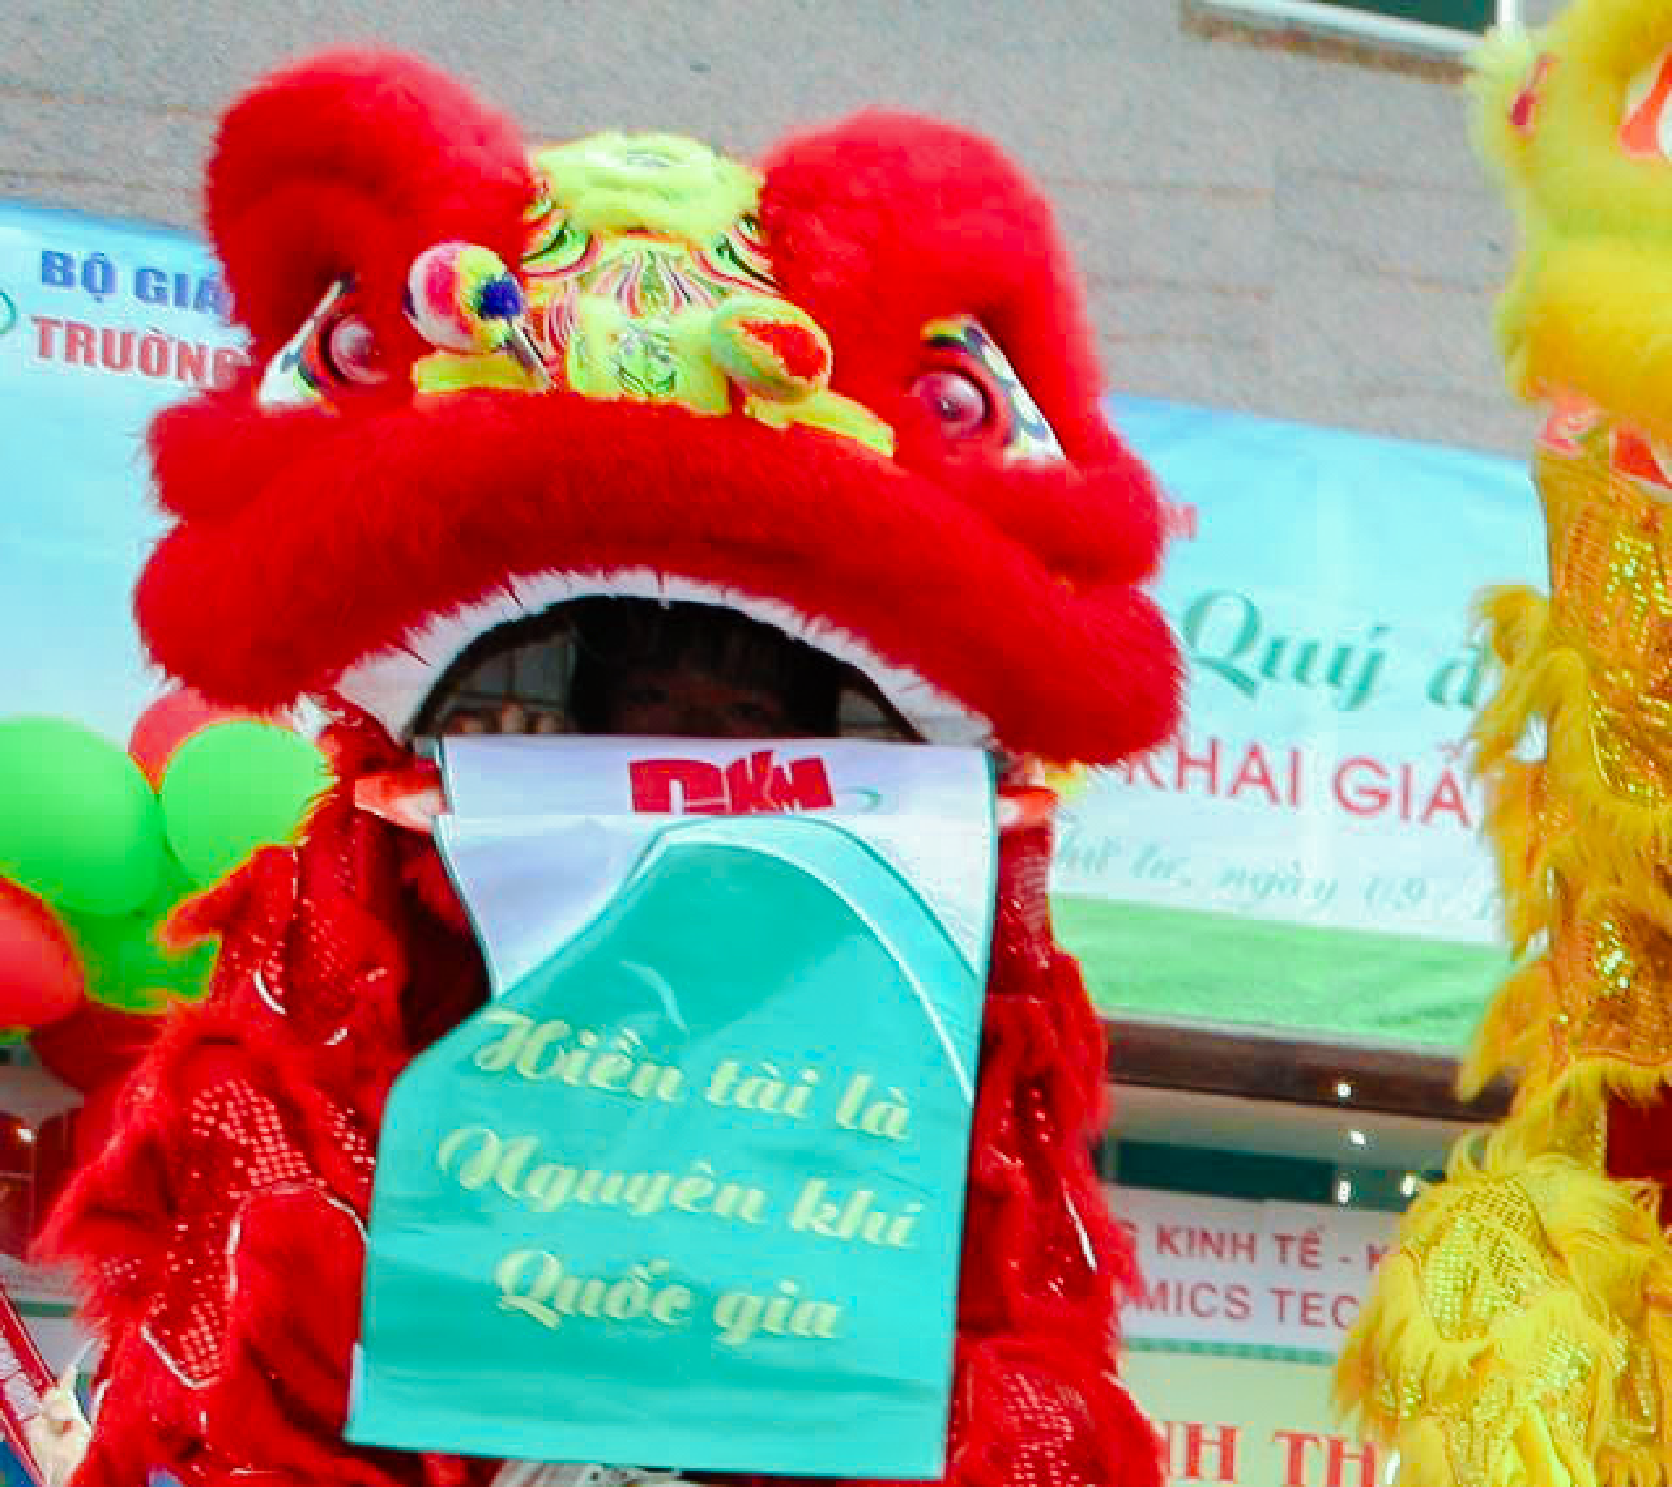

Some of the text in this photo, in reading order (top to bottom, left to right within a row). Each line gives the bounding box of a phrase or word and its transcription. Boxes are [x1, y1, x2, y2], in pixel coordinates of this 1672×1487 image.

[41, 250, 117, 302] BỘ
[1182, 589, 1389, 710] Quý
[474, 1011, 914, 1143] Hiền tài là
[437, 1127, 770, 1225] Nguyên
[1156, 1222, 1258, 1264] KINH
[493, 1250, 843, 1345] Quốc gia
